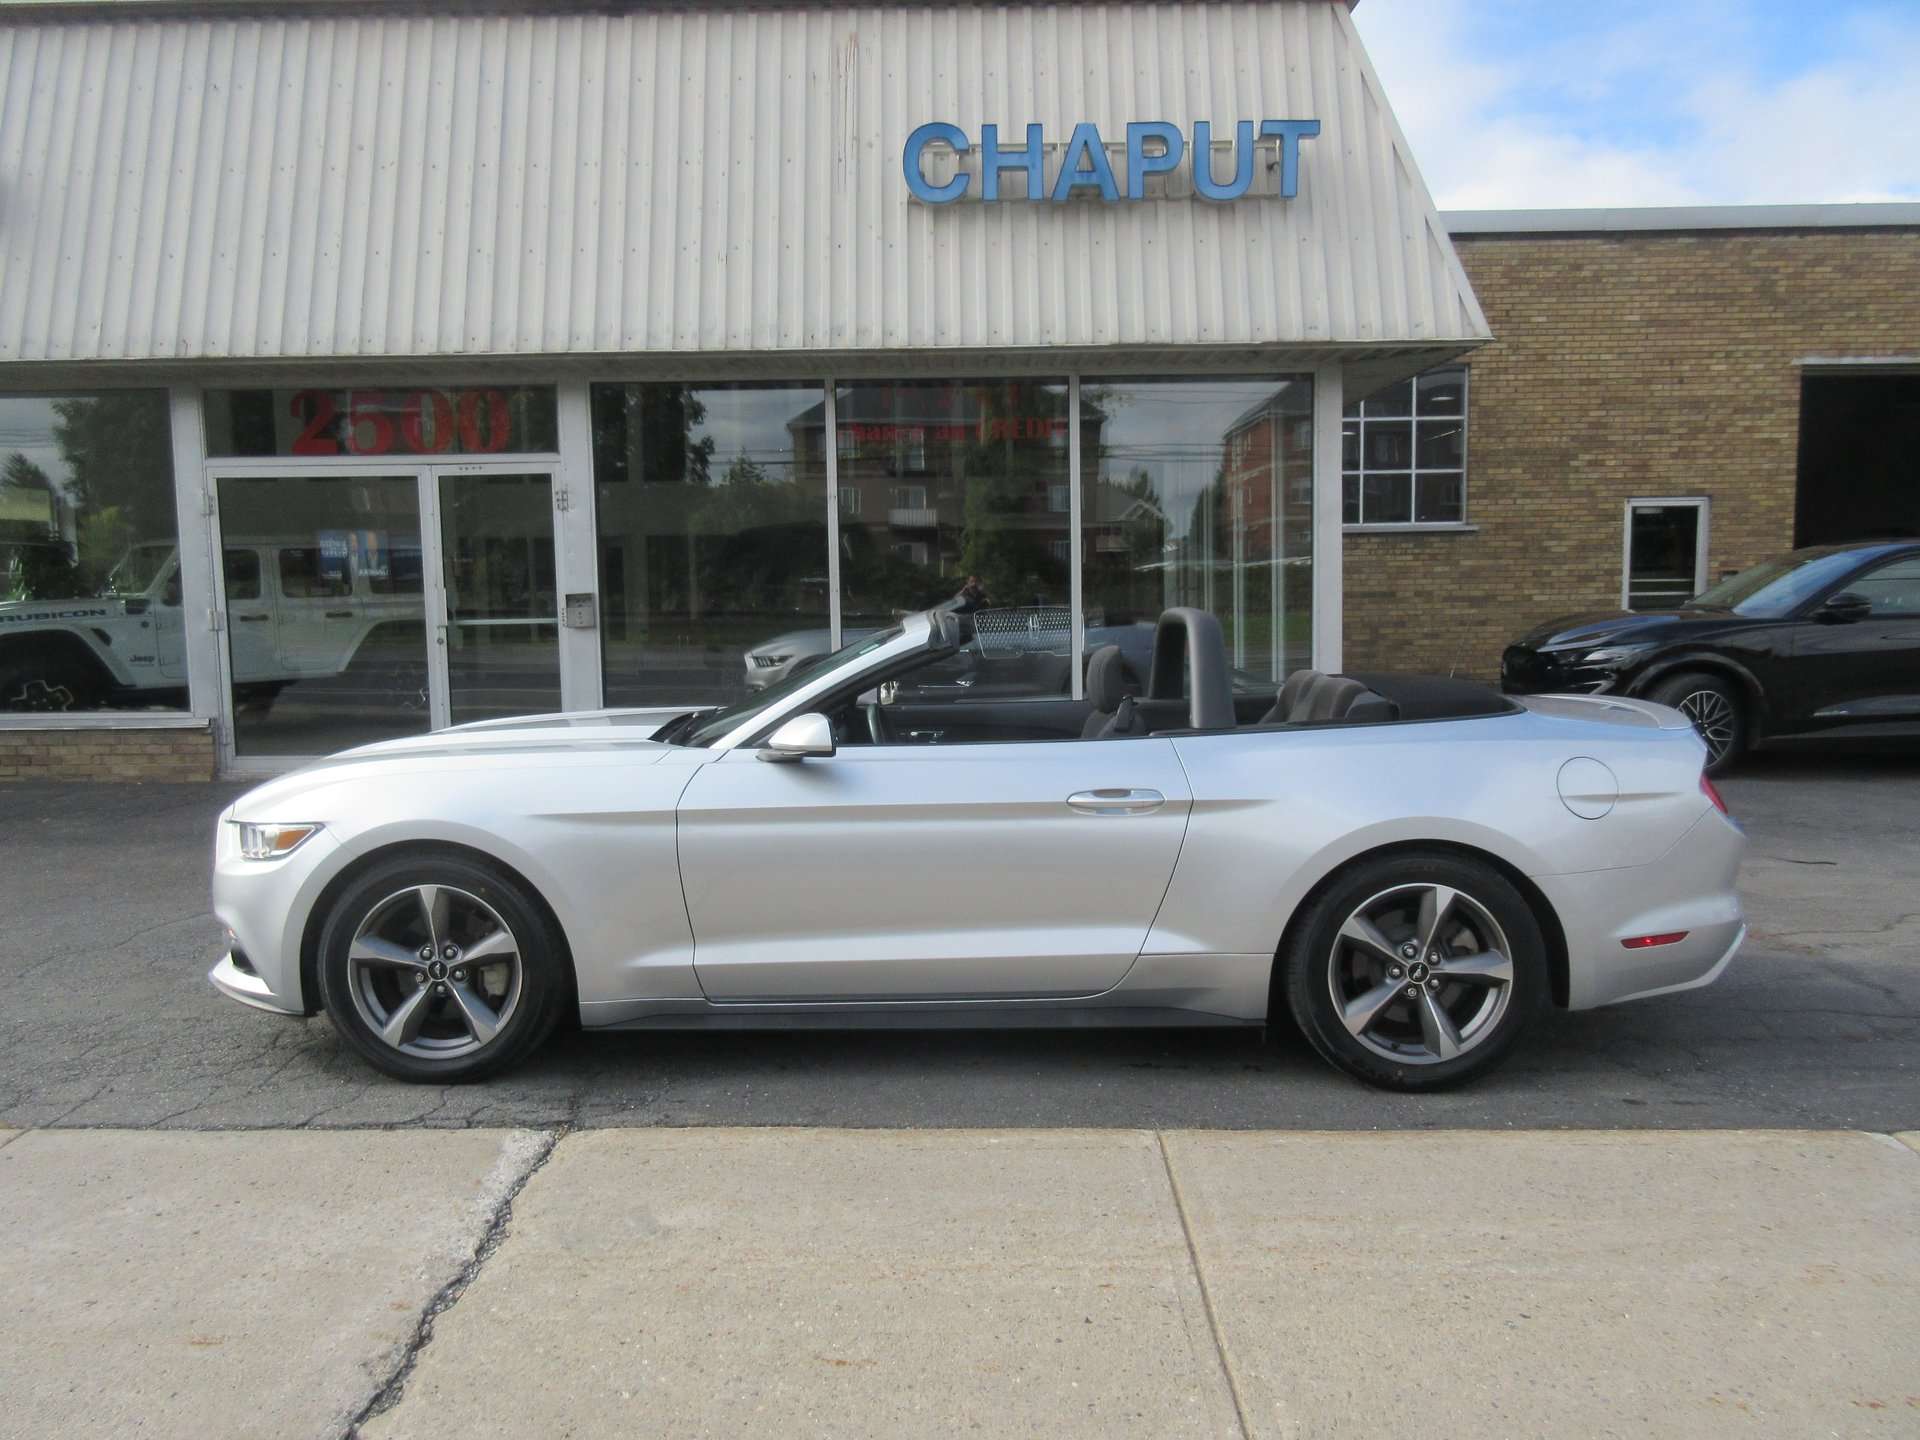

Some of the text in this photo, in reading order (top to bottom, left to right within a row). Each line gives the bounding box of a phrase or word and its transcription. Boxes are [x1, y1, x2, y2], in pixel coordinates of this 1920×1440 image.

[903, 120, 1321, 202] CHAPUT
[290, 388, 512, 455] 2500
[0, 609, 107, 622] RUBICON
